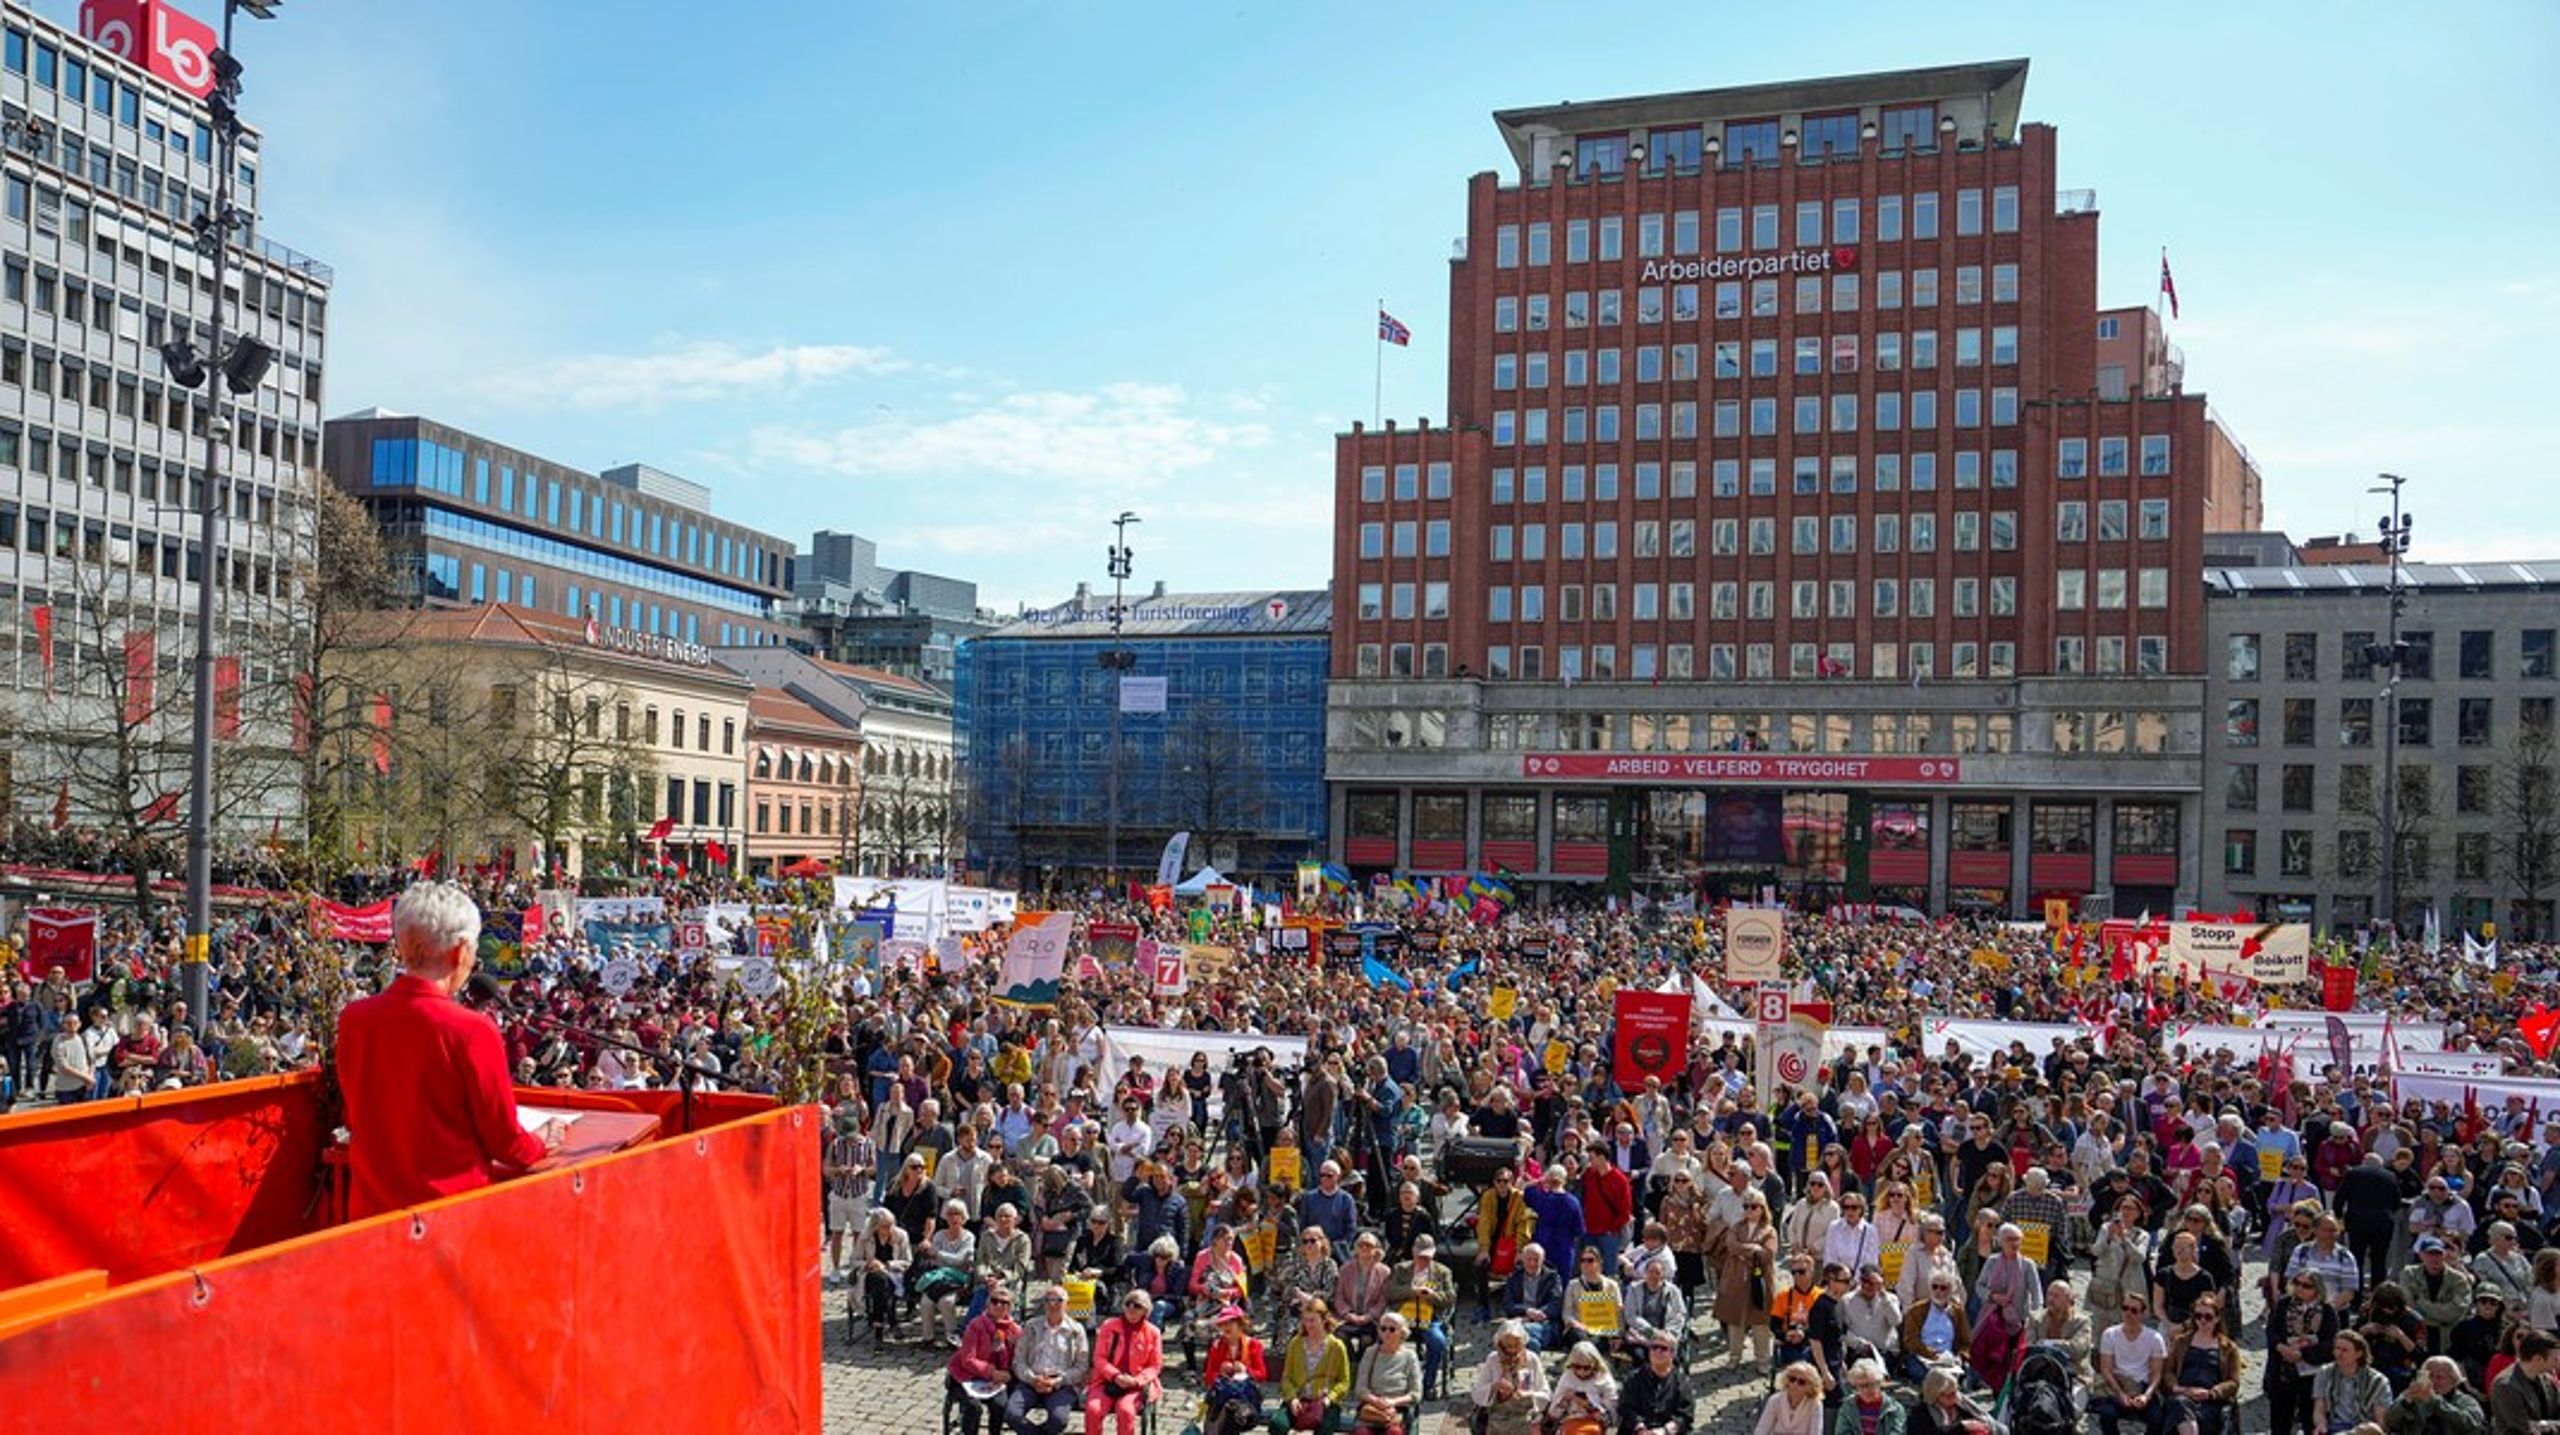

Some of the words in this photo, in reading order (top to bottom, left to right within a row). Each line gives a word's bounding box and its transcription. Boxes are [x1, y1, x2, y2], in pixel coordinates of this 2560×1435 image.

[157, 10, 210, 87] LO
[1641, 249, 1832, 281] Arbeiderpartiet
[1131, 603, 1250, 625] Turistforening
[666, 637, 712, 666] ENERGI
[1606, 759, 1669, 775] ARBEID
[1684, 760, 1761, 776] VELFERD
[1776, 760, 1869, 777] TRYGGHET
[37, 928, 58, 940] FO
[686, 927, 700, 944] 6
[2190, 926, 2236, 941] Stopp
[2253, 954, 2303, 966] Boikott
[1160, 960, 1178, 982] 7
[2253, 967, 2285, 977] Israel
[1762, 994, 1784, 1020] 8
[1925, 1018, 1949, 1034] SV
[2165, 1023, 2193, 1038] SV
